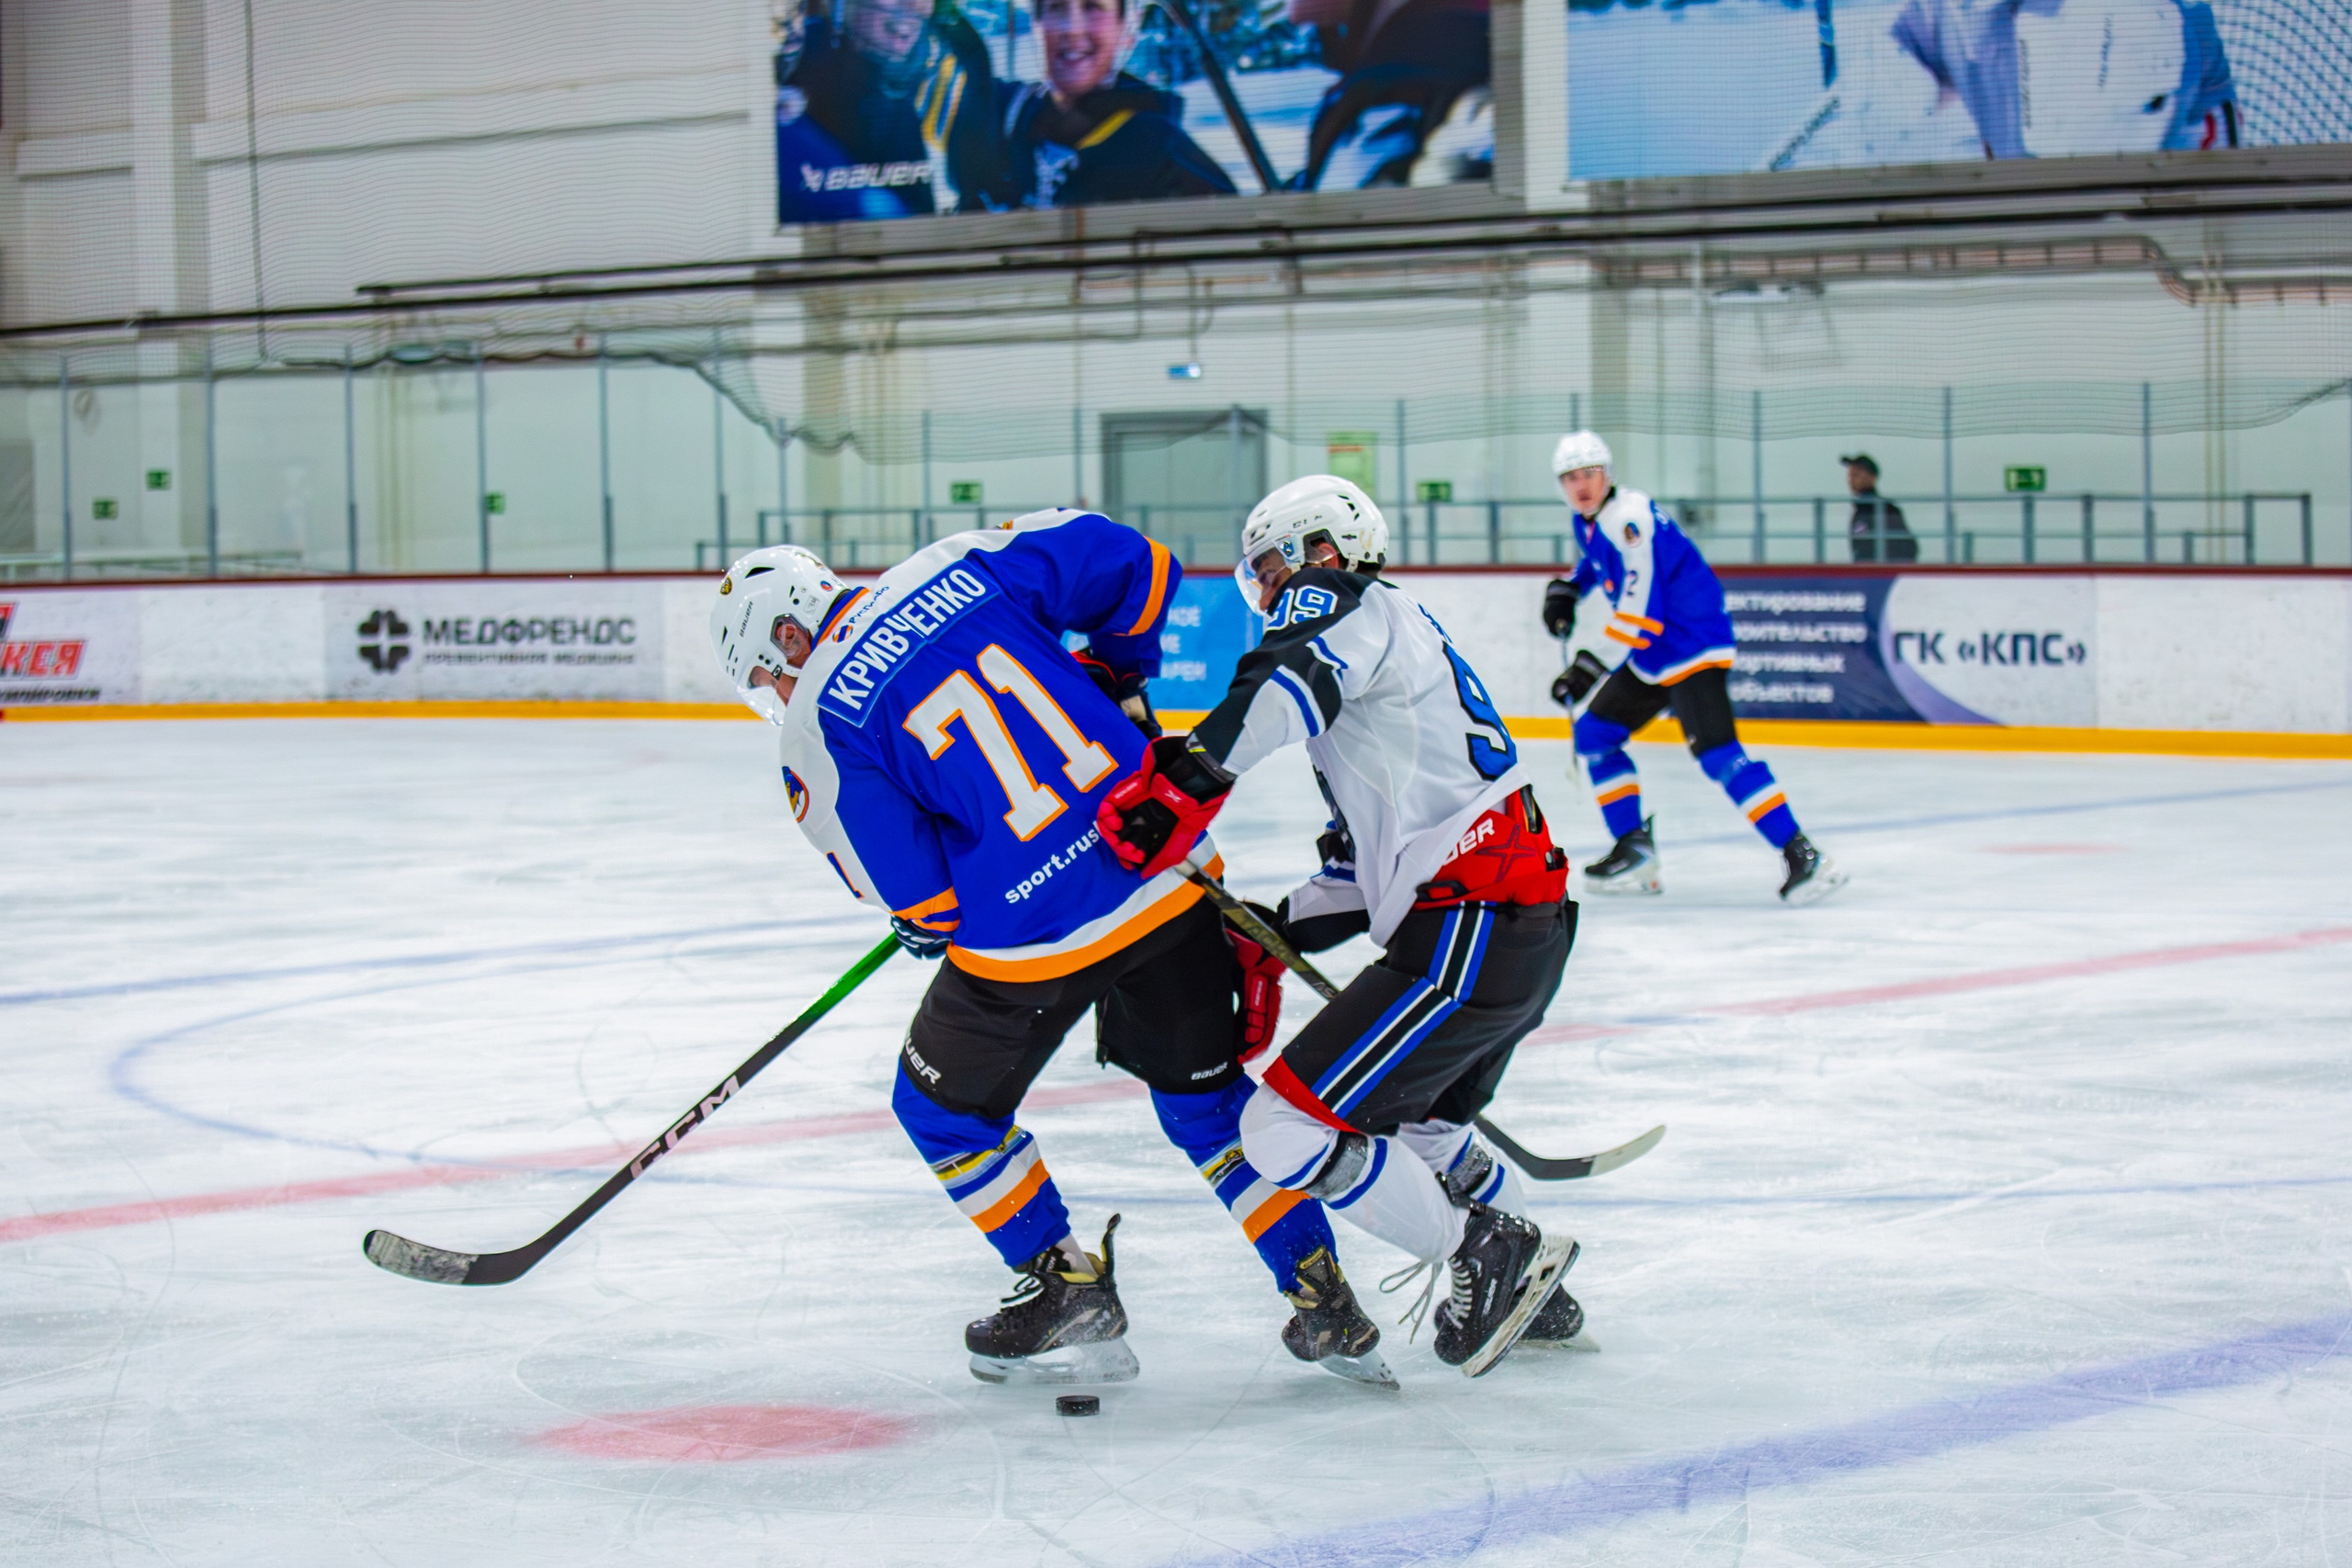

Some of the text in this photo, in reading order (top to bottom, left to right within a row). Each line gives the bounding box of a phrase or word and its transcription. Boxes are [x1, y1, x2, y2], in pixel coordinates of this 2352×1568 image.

[1724, 591, 1867, 616] ектирование
[423, 617, 637, 645] МЕДФРЕНДС
[828, 569, 987, 711] КРИВЧЕНКО
[1894, 631, 2086, 666] ГК «КПС»
[0, 642, 85, 676] КЕЯ
[1733, 653, 1846, 675] ортивных
[901, 643, 1120, 842] 71
[904, 1037, 942, 1085] UER
[629, 1074, 741, 1179] CCM
